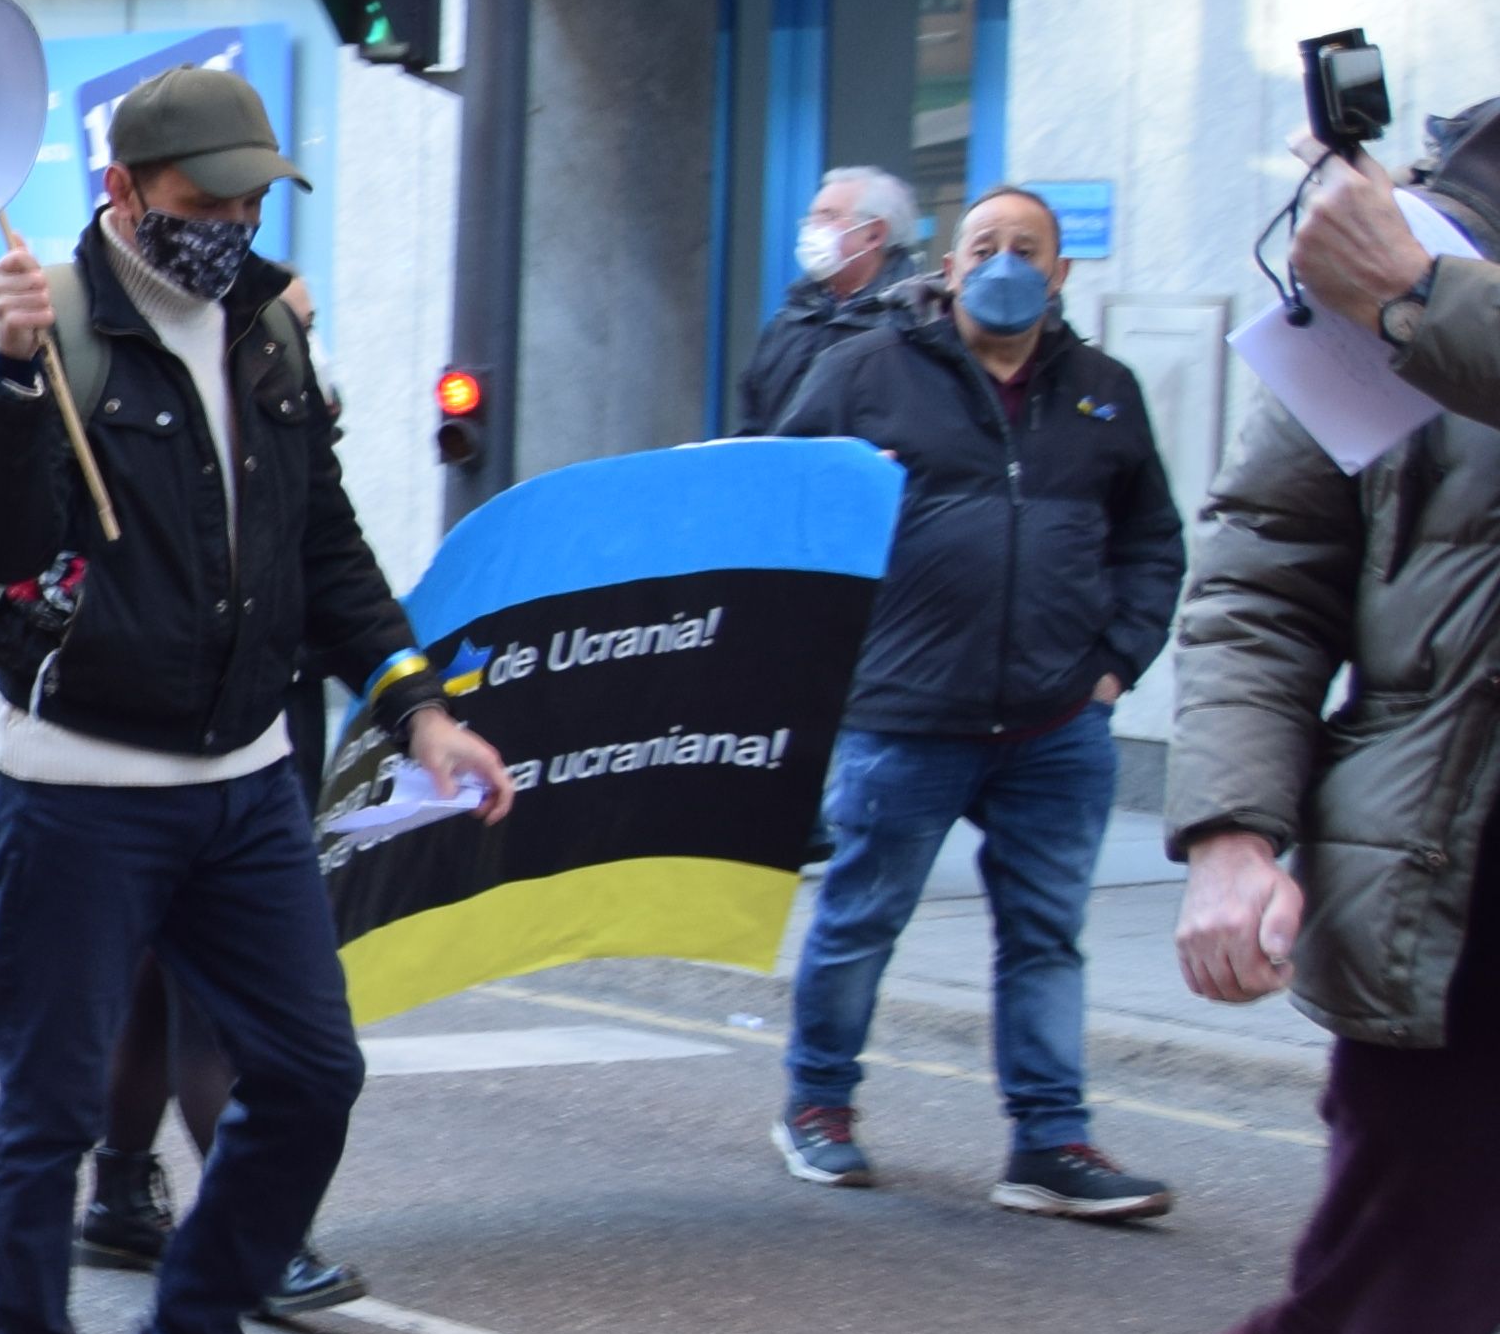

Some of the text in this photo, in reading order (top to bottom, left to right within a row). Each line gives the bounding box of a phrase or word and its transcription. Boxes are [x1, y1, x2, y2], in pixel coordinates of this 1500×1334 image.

[487, 607, 724, 688] de Ucrania!
[547, 725, 791, 787] ucraniana!
